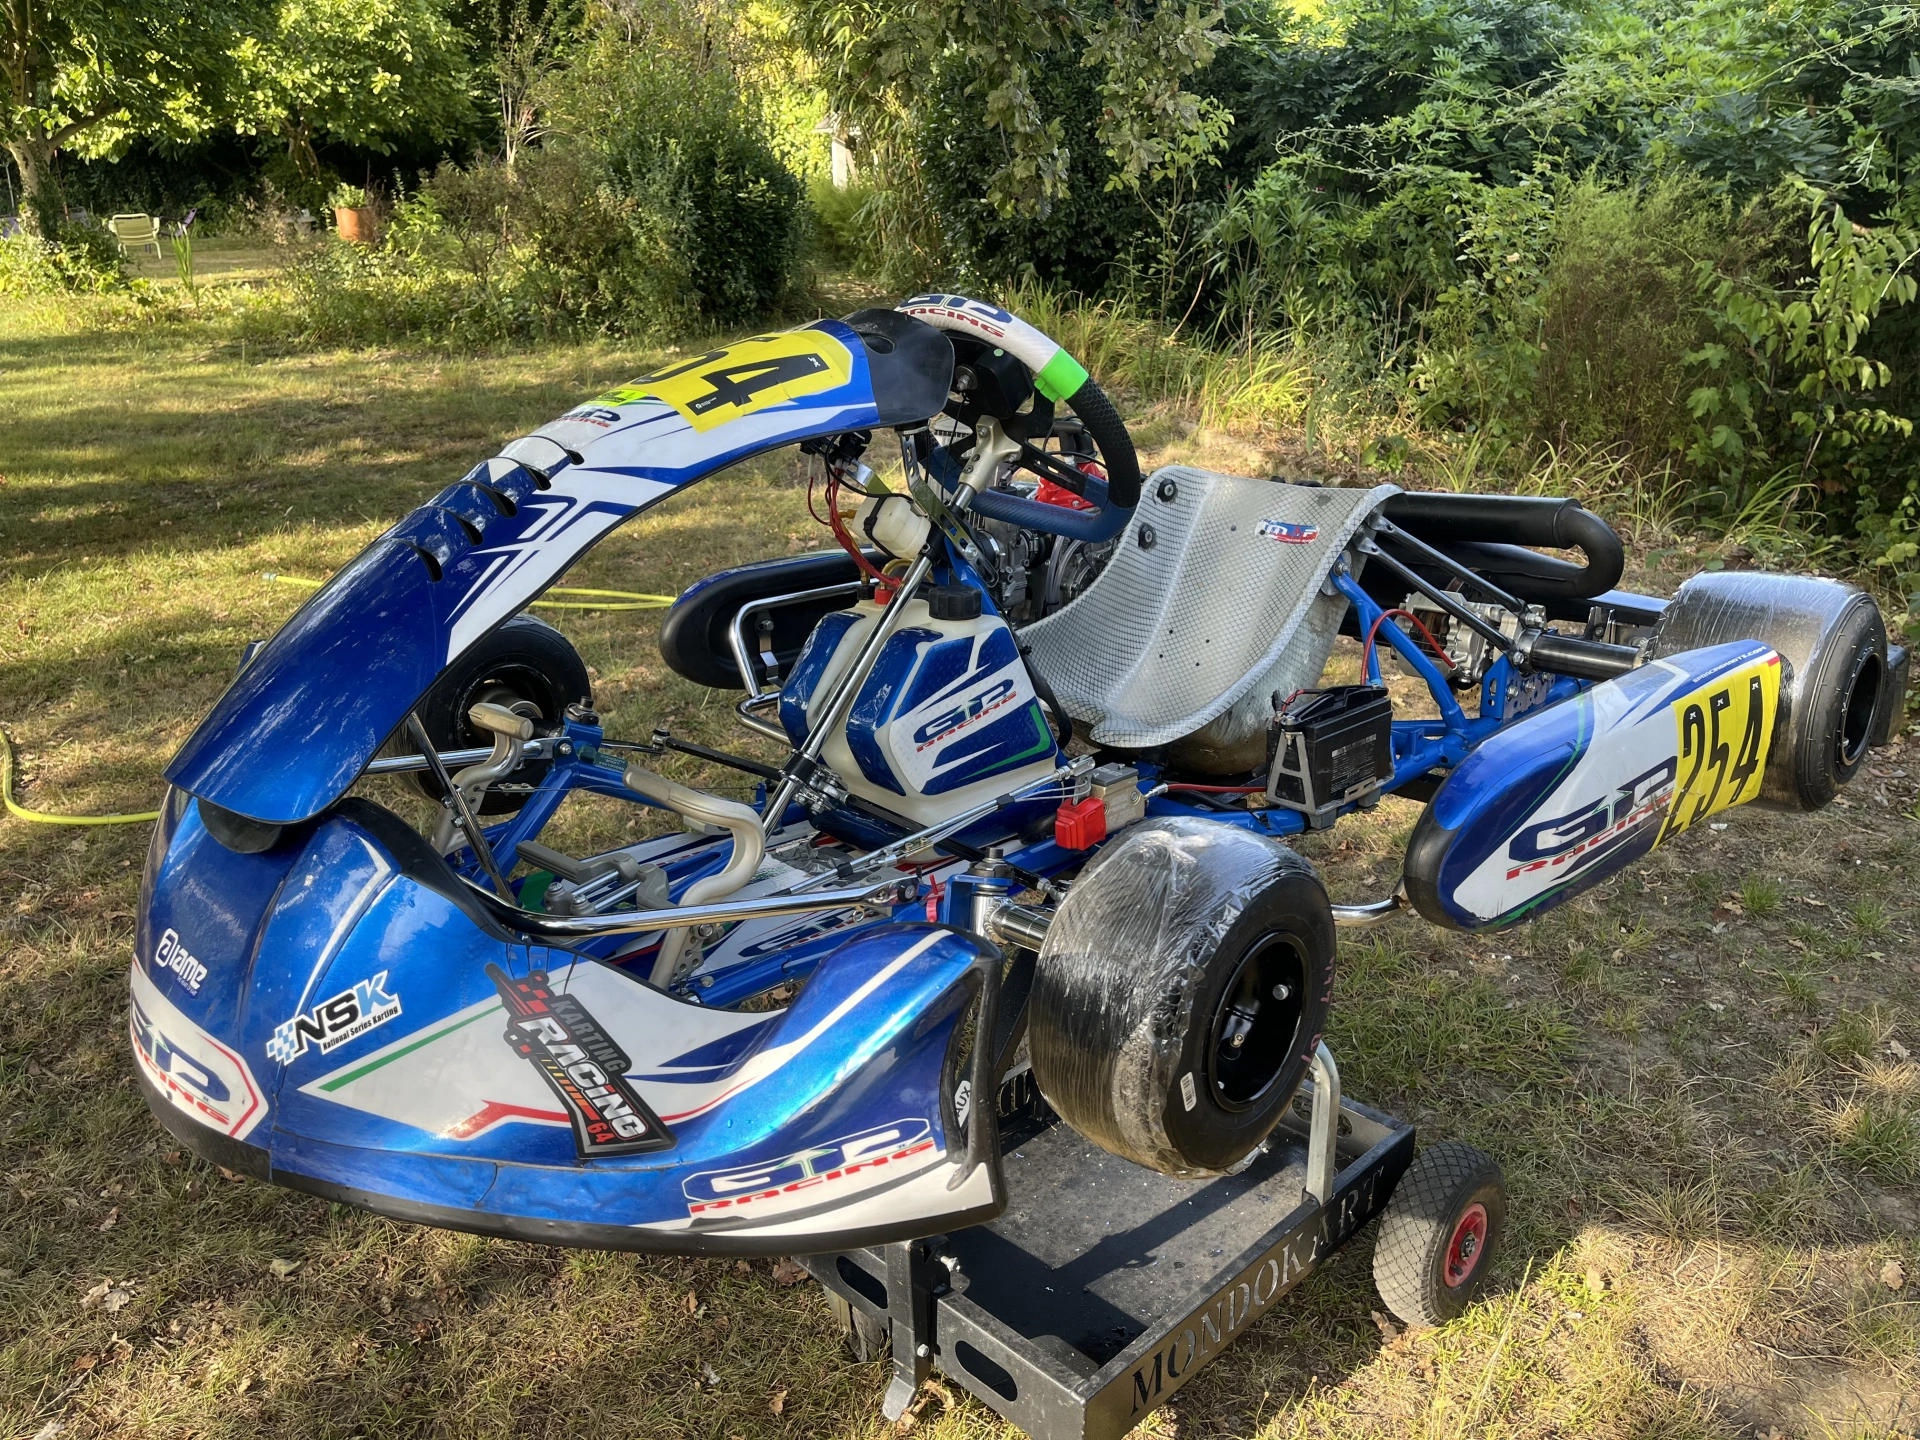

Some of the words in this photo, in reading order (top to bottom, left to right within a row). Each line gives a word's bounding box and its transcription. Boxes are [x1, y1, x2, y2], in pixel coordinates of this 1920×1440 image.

[902, 307, 1005, 338] ACING
[916, 691, 1017, 753] RACING
[1657, 675, 1763, 846] 254
[294, 973, 396, 1055] NSK
[322, 1031, 350, 1051] National
[350, 1021, 372, 1037] Series
[372, 1006, 399, 1024] Karting
[550, 1000, 627, 1072] KARTING
[587, 1122, 612, 1143] 64
[689, 1140, 935, 1214] RACING
[1128, 1165, 1385, 1418] MONDOKART
